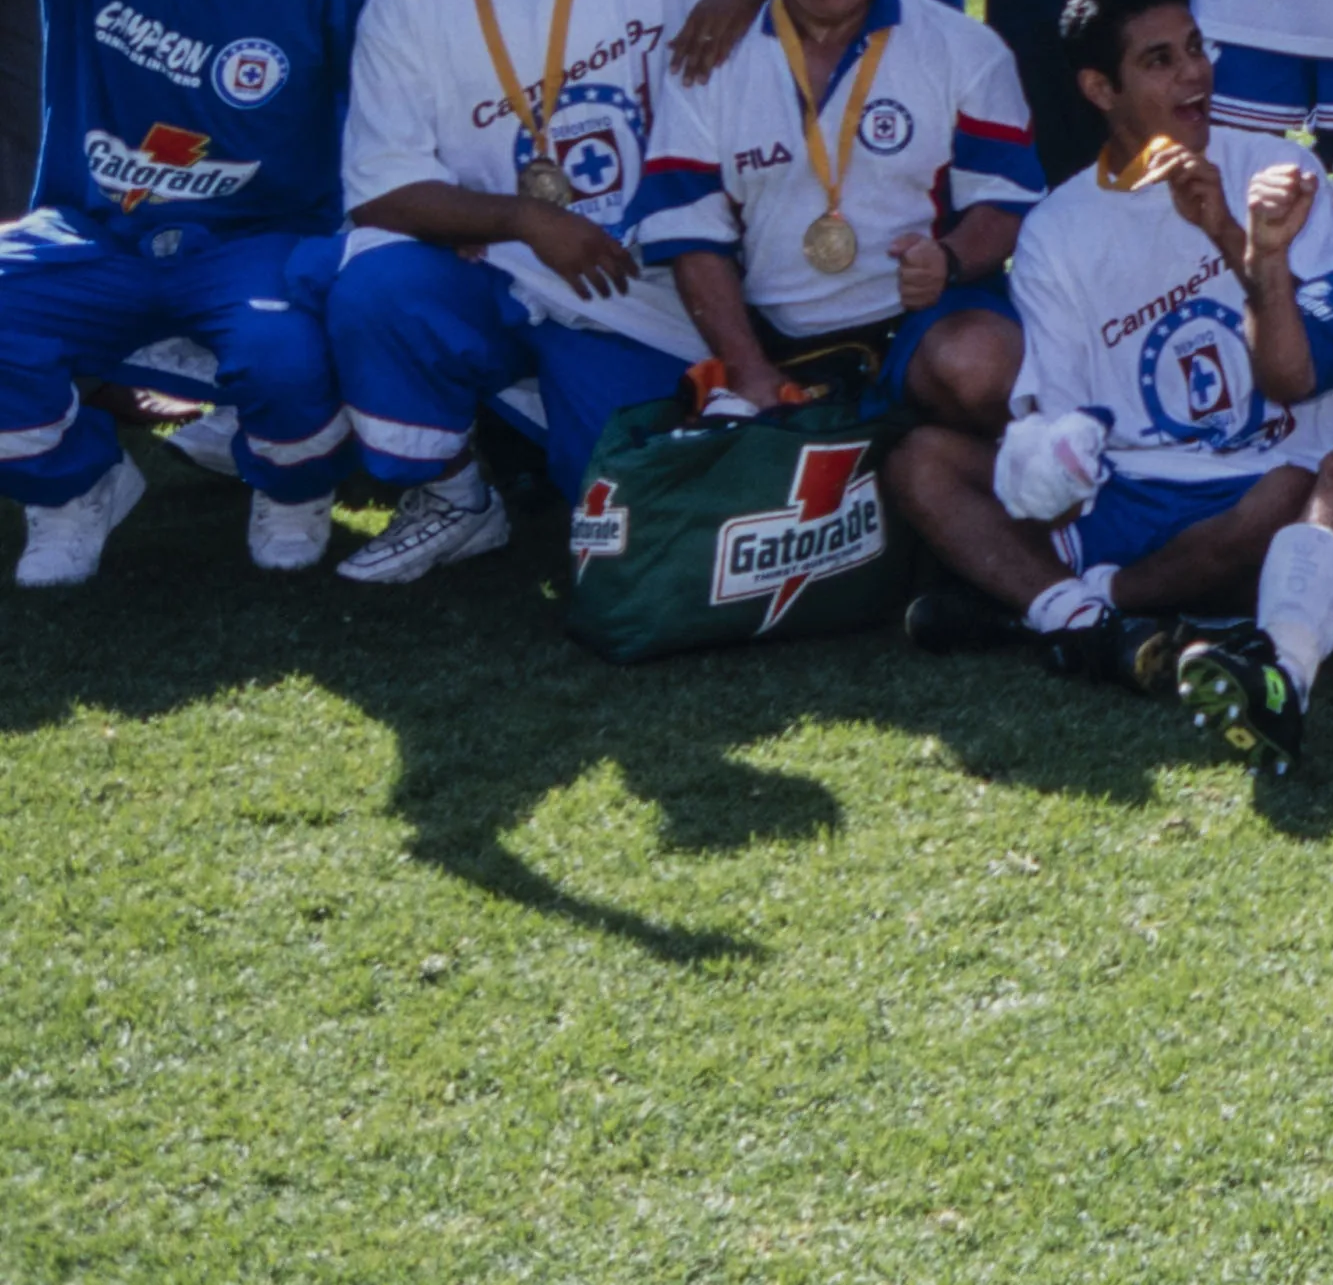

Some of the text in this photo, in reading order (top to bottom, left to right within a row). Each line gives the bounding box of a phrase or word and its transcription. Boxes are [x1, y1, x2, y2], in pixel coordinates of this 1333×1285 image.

[95, 0, 214, 73] CAMPEON
[626, 19, 664, 53] 97
[88, 139, 240, 194] Gatorade
[734, 141, 793, 175] FILA
[571, 519, 620, 540] atorade
[730, 498, 878, 576] Gatorade
